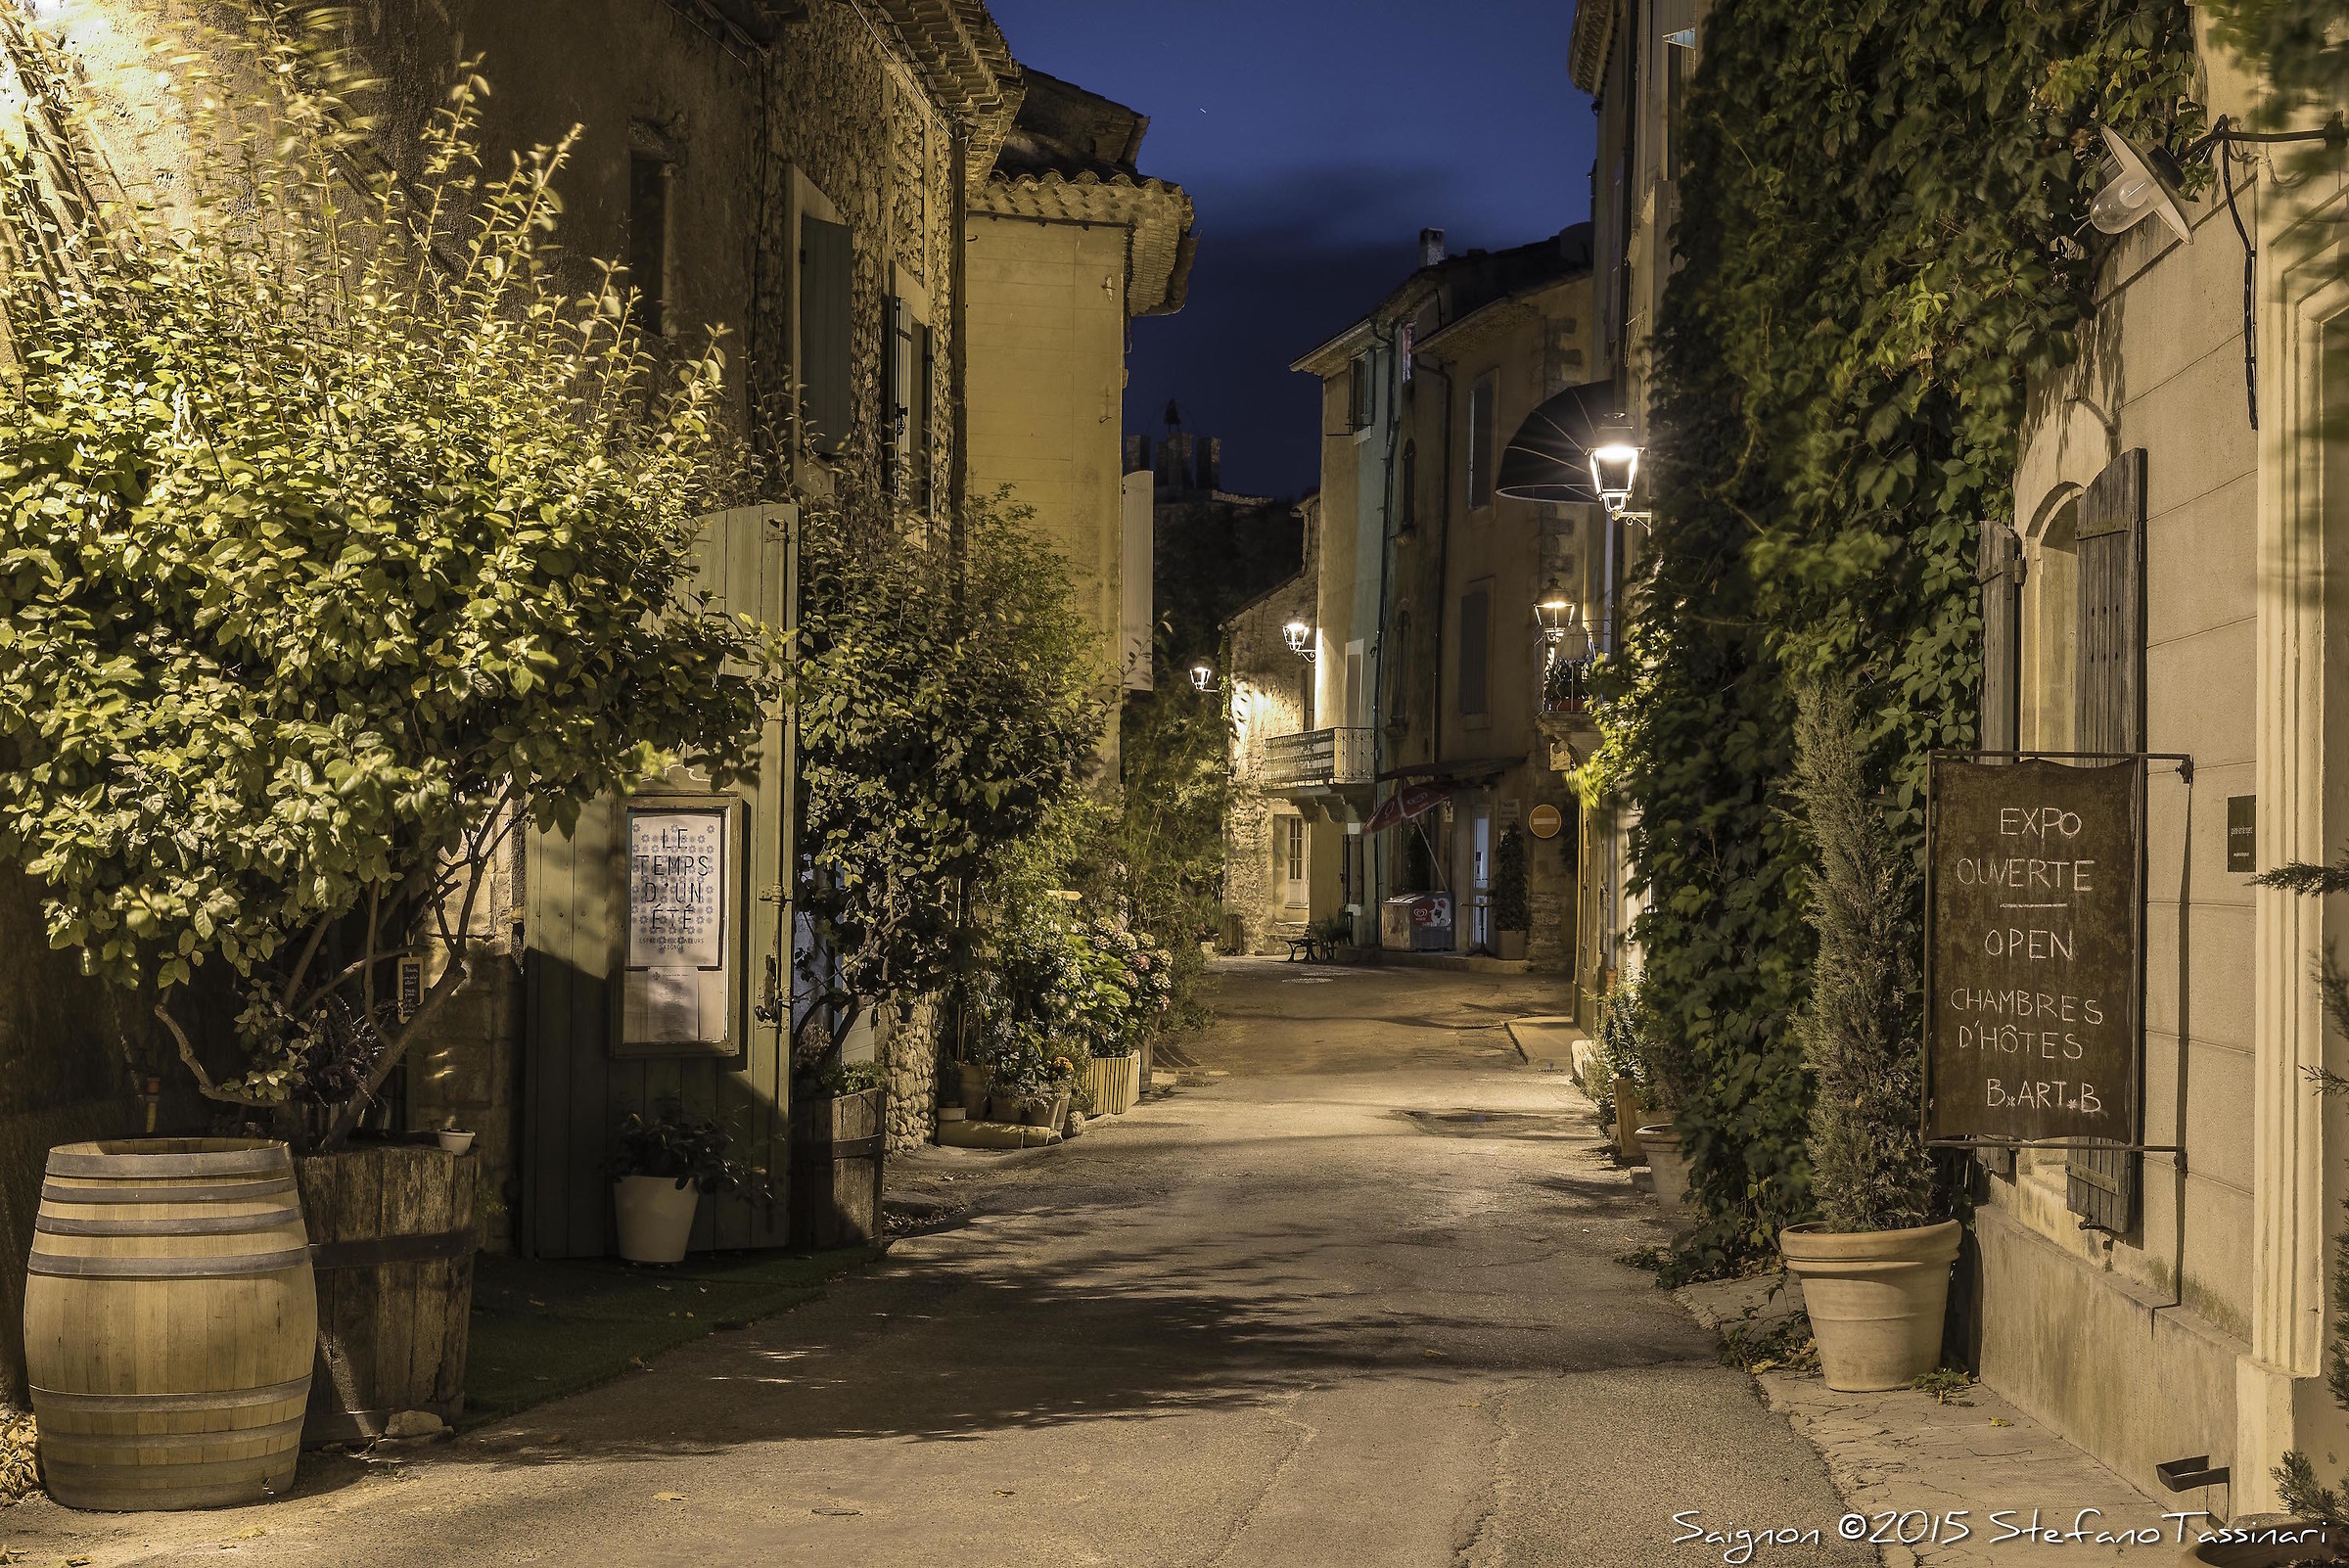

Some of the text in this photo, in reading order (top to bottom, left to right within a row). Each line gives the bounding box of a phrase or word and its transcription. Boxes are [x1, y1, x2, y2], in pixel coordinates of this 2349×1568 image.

[662, 828, 688, 850] LE
[2000, 807, 2083, 839] EXPO
[635, 854, 710, 877] TEMPS
[1956, 857, 2096, 893] OUVERTE
[645, 882, 702, 903] D'UN
[652, 903, 695, 930] ÉTÉ
[1984, 929, 2075, 961] OPEN
[1950, 988, 2104, 1026] CHAMBRES
[1958, 1020, 2085, 1060] D'HÔTES
